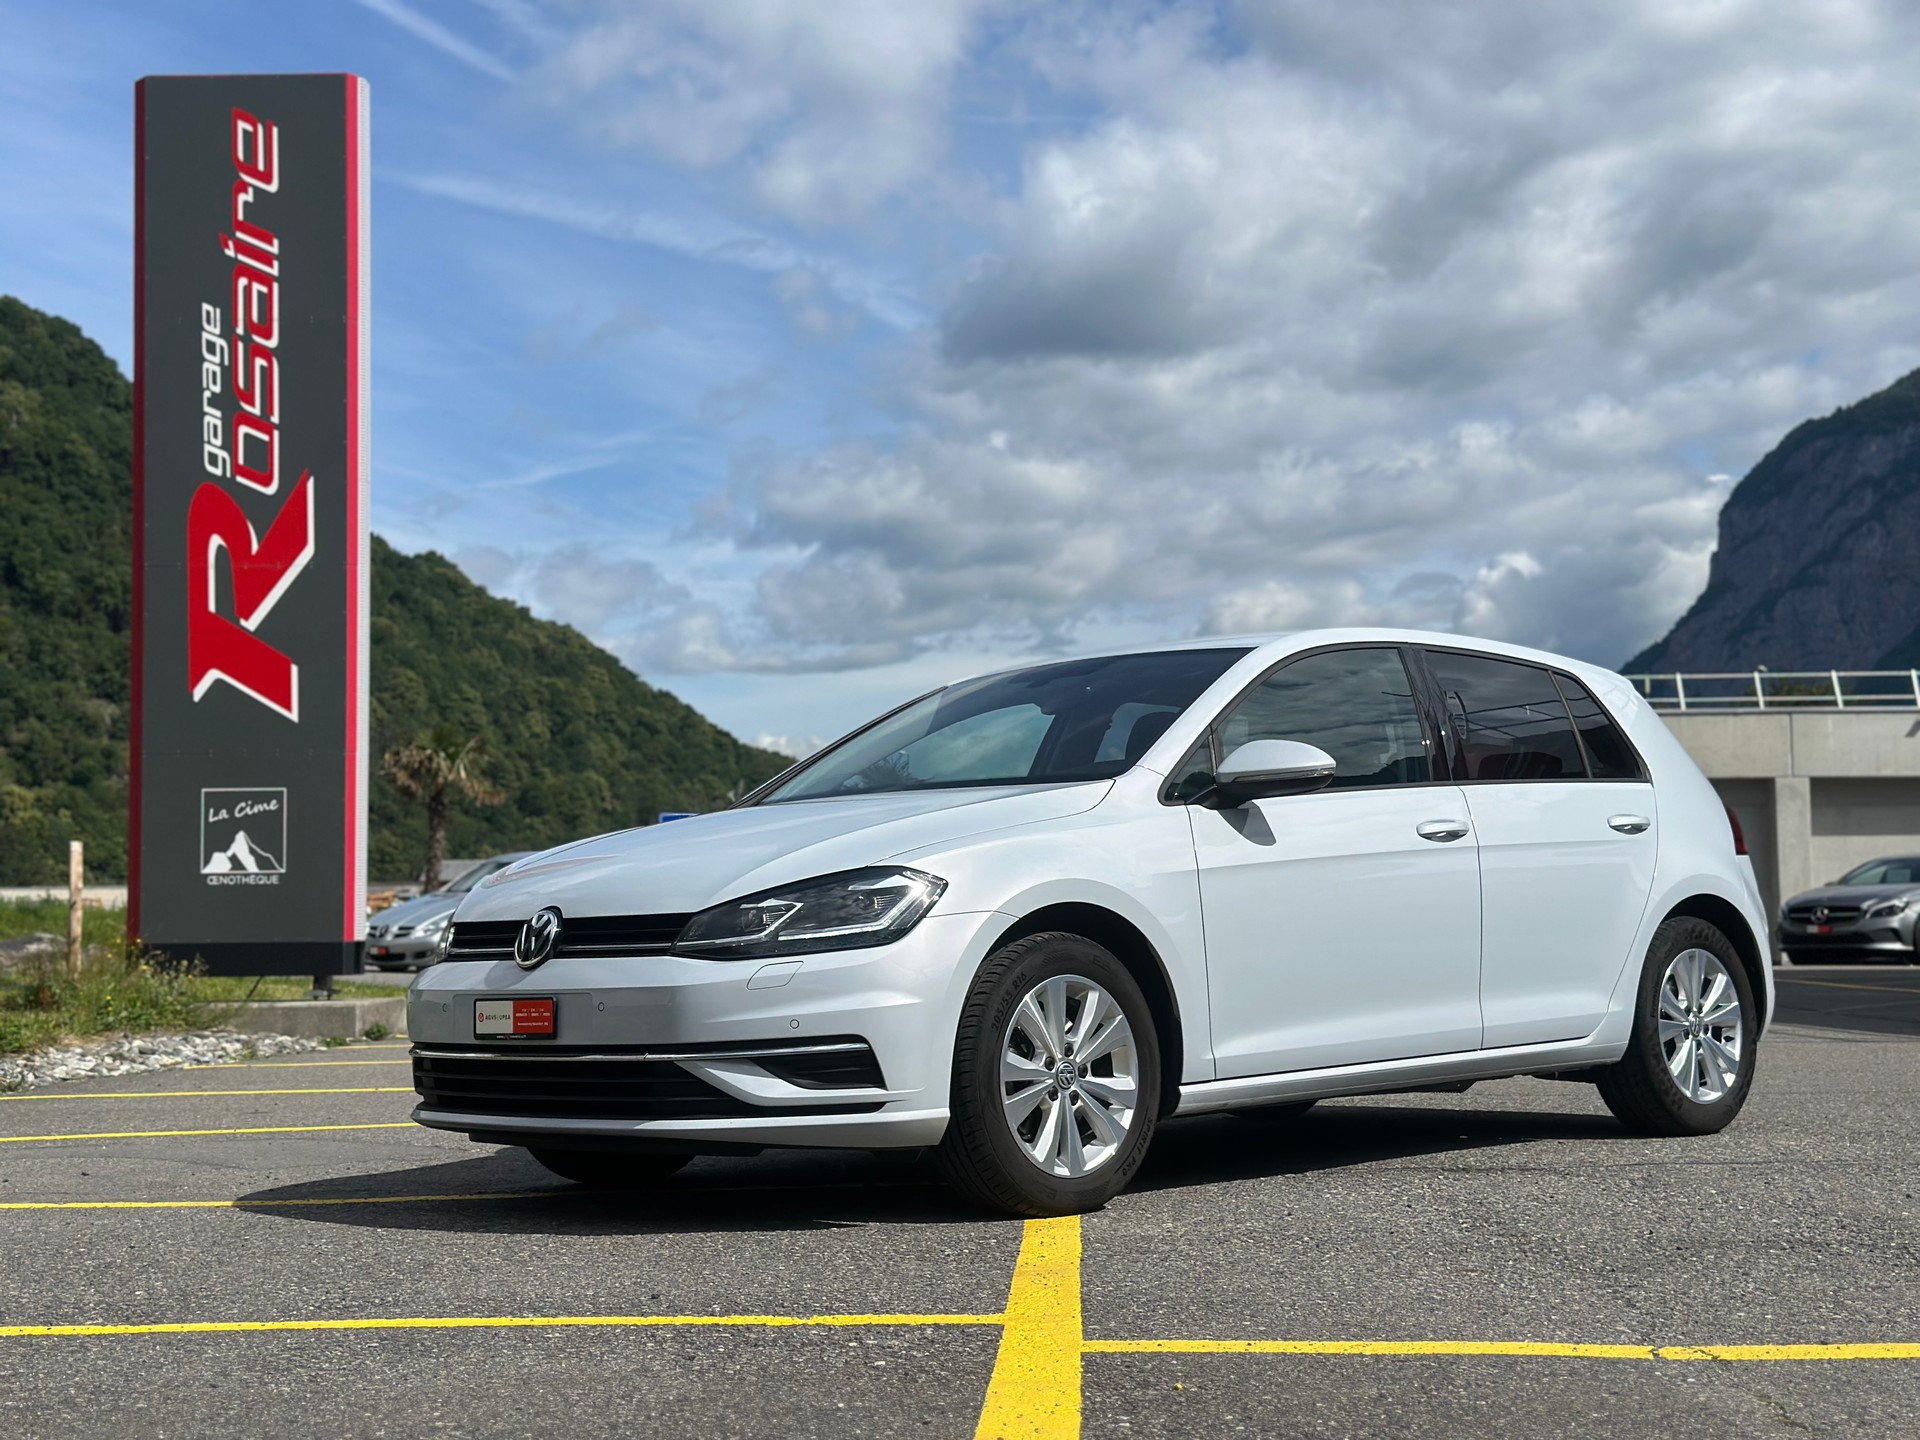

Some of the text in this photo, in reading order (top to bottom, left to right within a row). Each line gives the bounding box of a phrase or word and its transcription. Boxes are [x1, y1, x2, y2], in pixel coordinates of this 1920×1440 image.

[201, 302, 231, 478] garage
[187, 107, 315, 724] Rosaire
[208, 799, 279, 822] La Cime
[1012, 971, 1028, 990] R16
[1121, 1155, 1137, 1177] PRO
